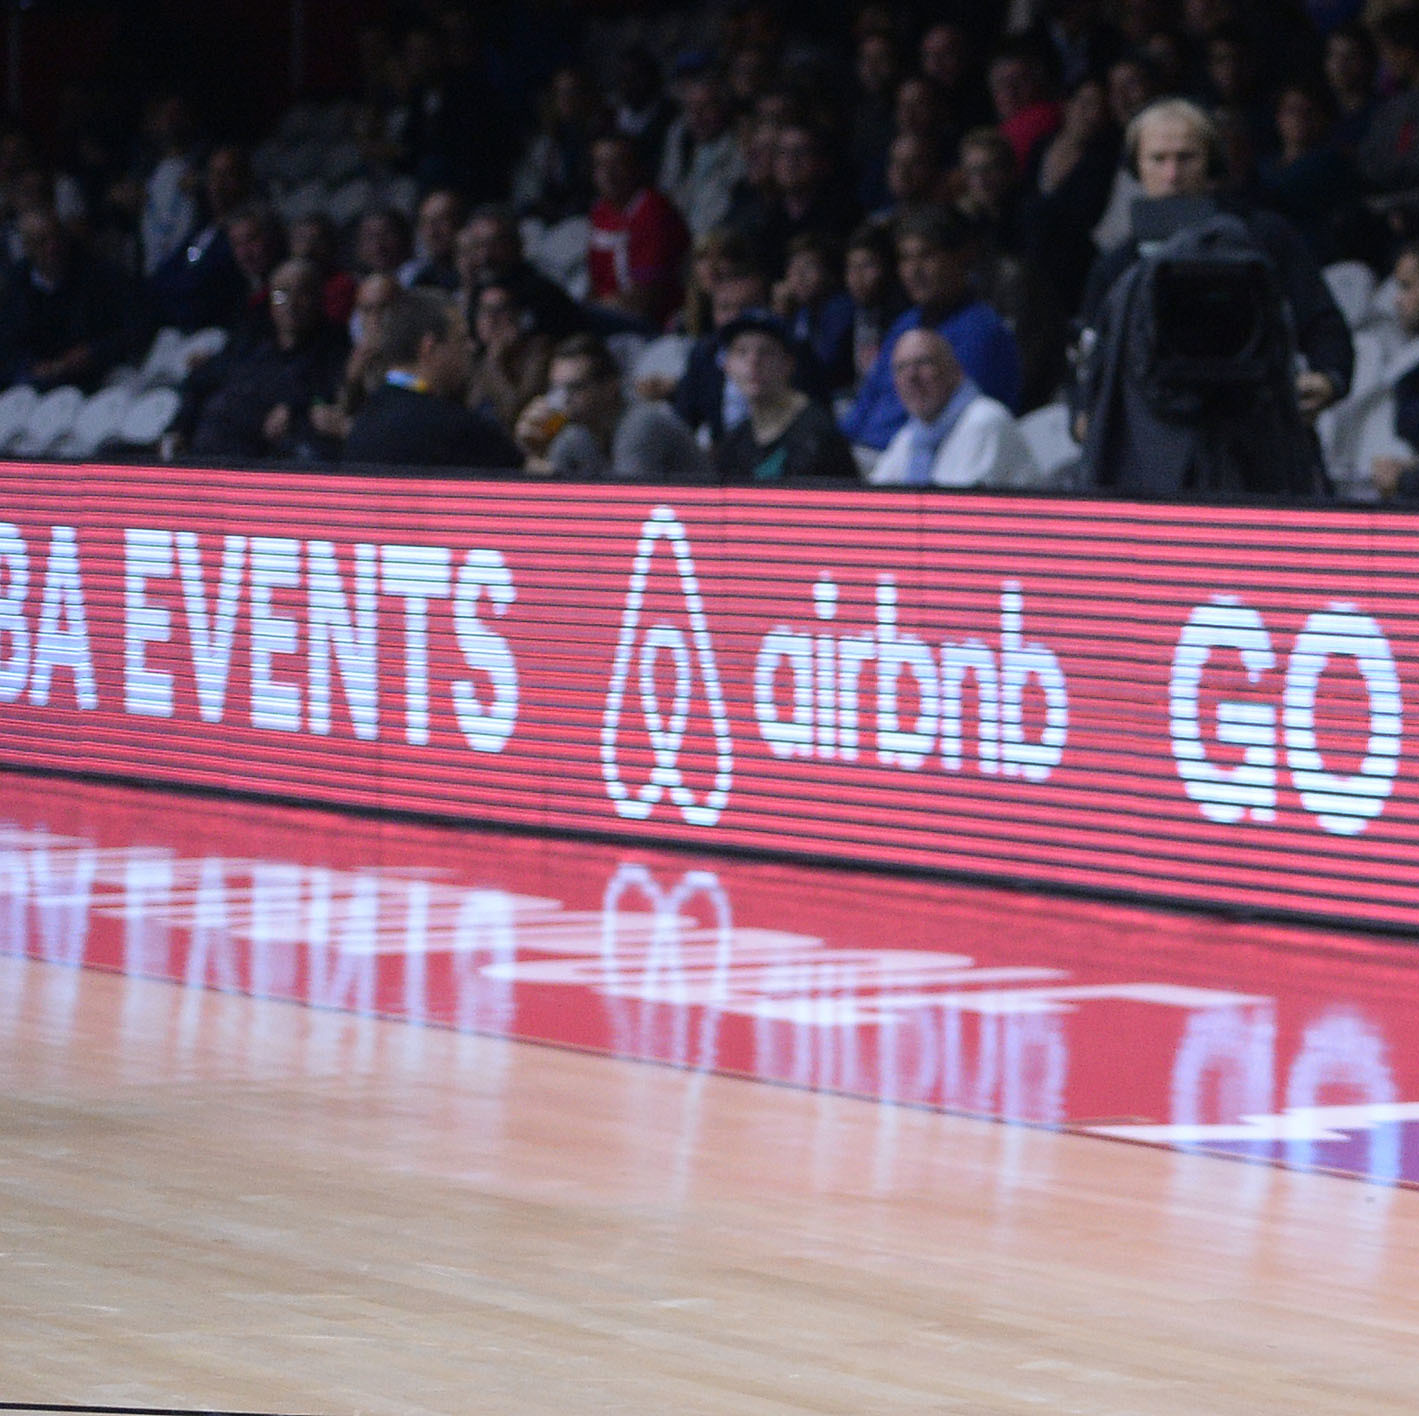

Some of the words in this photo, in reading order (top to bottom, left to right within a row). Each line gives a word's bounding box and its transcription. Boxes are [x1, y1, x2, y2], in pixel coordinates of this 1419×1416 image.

[124, 527, 520, 753] EVENTS
[754, 569, 1070, 783] airbnb
[1169, 594, 1402, 836] GO
